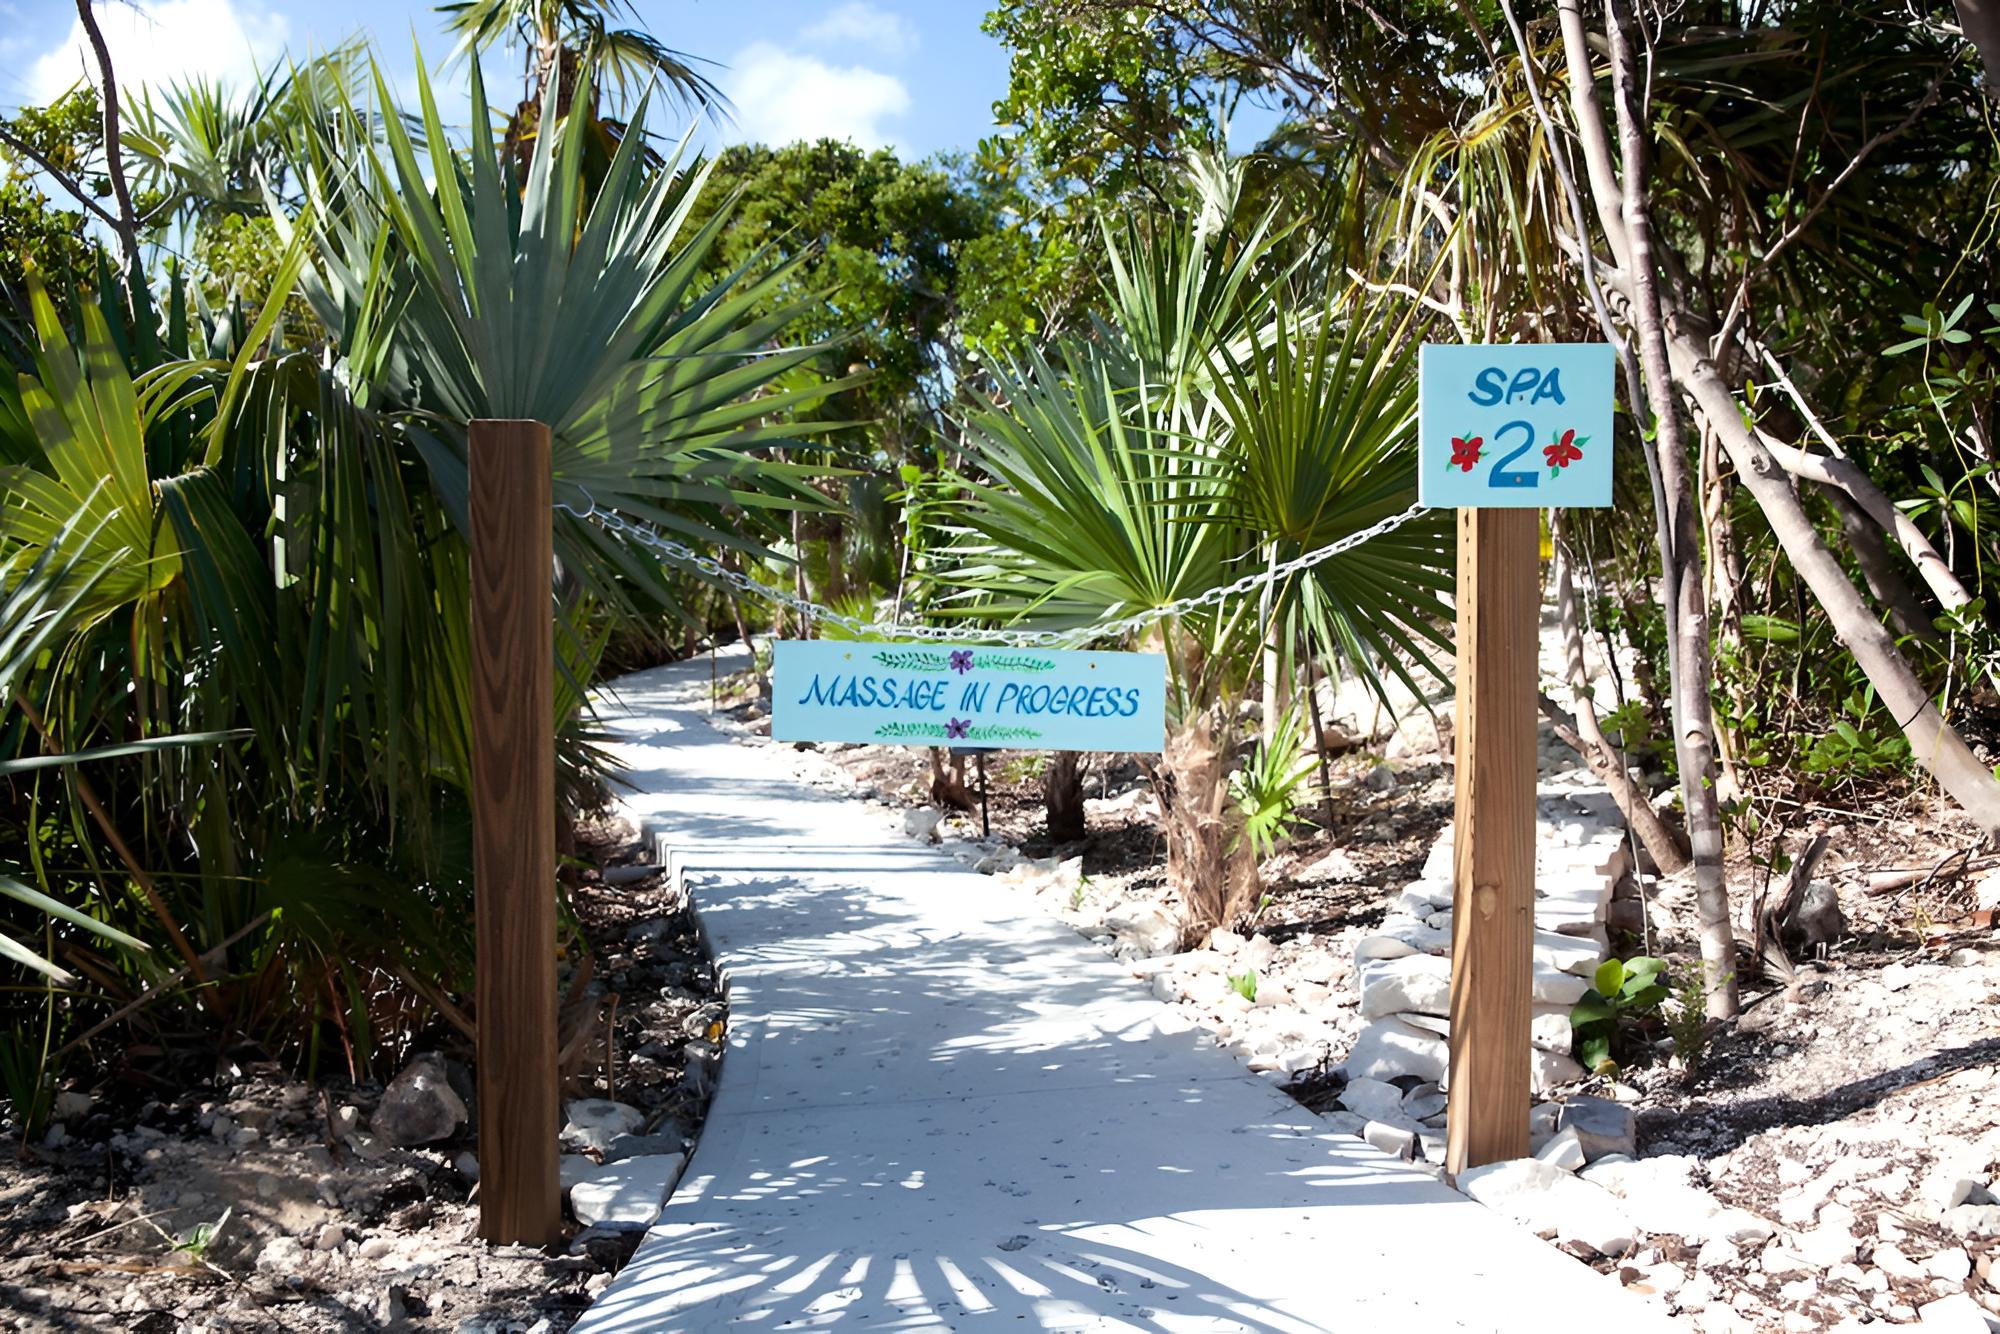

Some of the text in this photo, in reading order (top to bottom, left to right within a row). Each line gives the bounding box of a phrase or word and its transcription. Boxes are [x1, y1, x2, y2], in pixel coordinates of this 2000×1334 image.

[1467, 367, 1566, 407] SPA
[1488, 420, 1540, 488] 2
[798, 674, 1140, 717] MASSAGE IN PROGRESS
